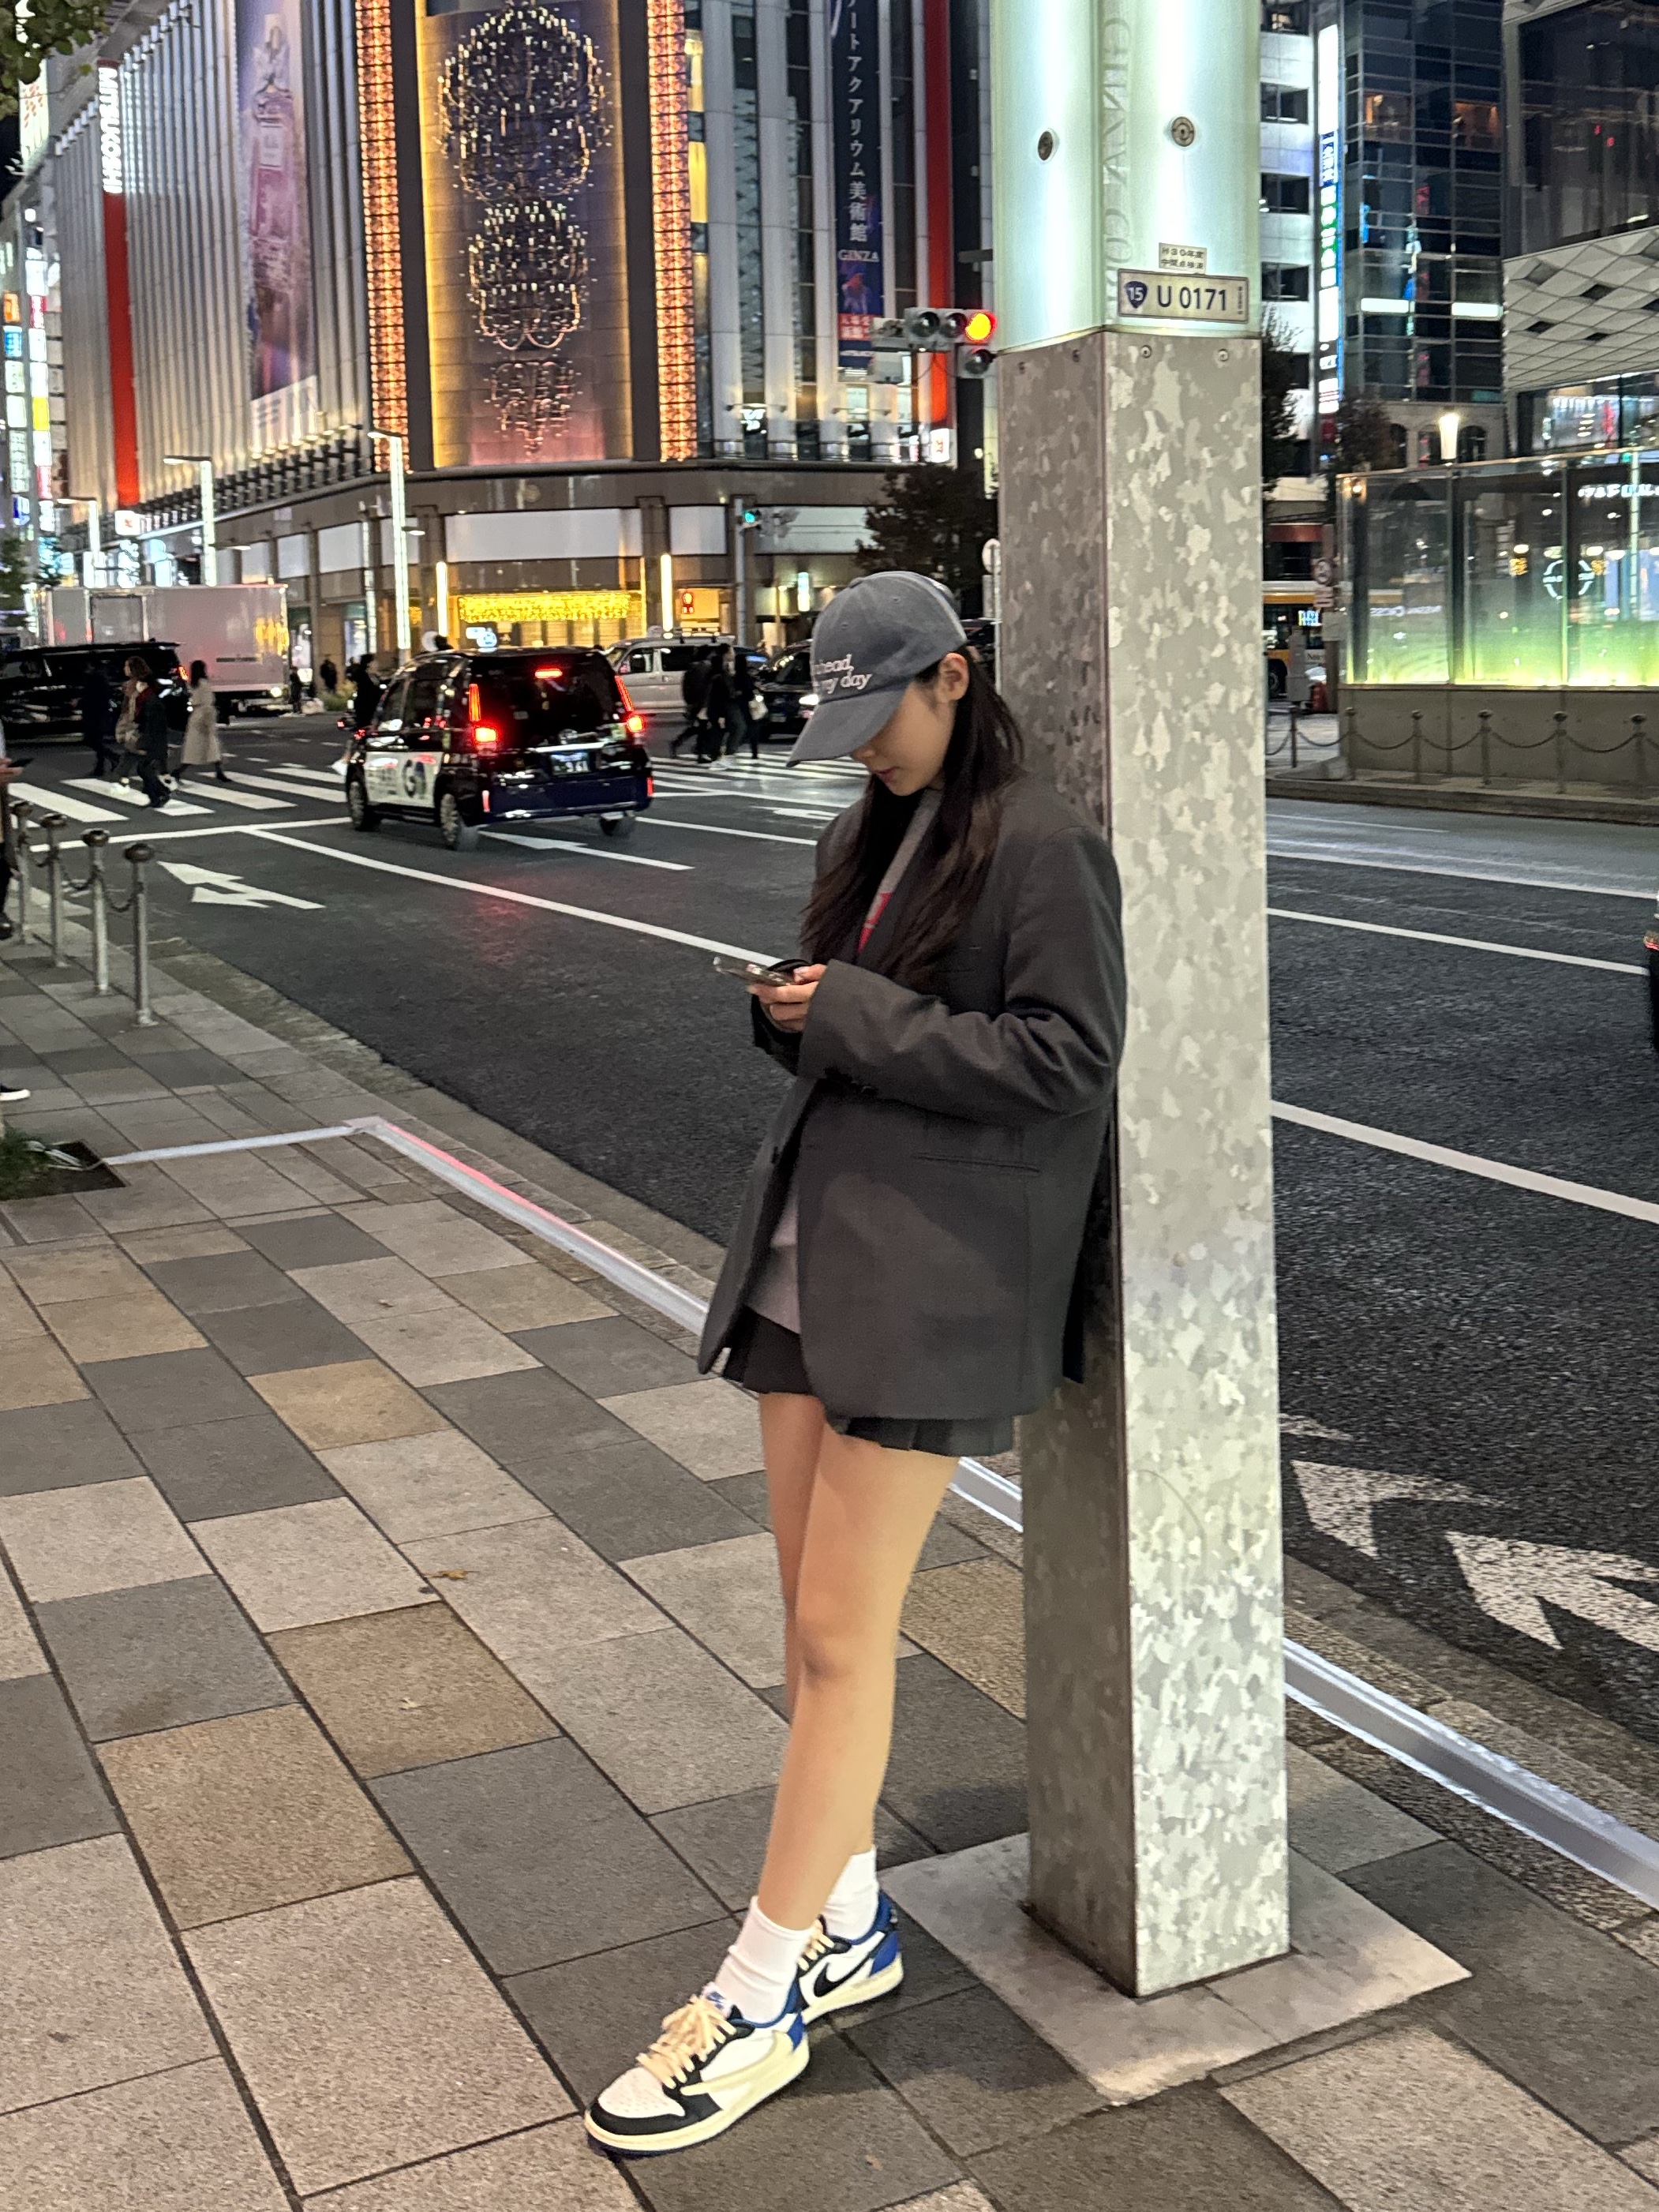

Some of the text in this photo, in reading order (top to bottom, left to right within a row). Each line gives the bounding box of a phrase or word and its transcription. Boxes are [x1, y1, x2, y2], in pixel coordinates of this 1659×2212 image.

[99, 67, 123, 194] MITSUKOSHI
[838, 249, 880, 263] GINZA
[1129, 287, 1144, 302] 15
[1157, 285, 1172, 308] U
[1179, 286, 1226, 311] 0171
[840, 670, 873, 690] day
